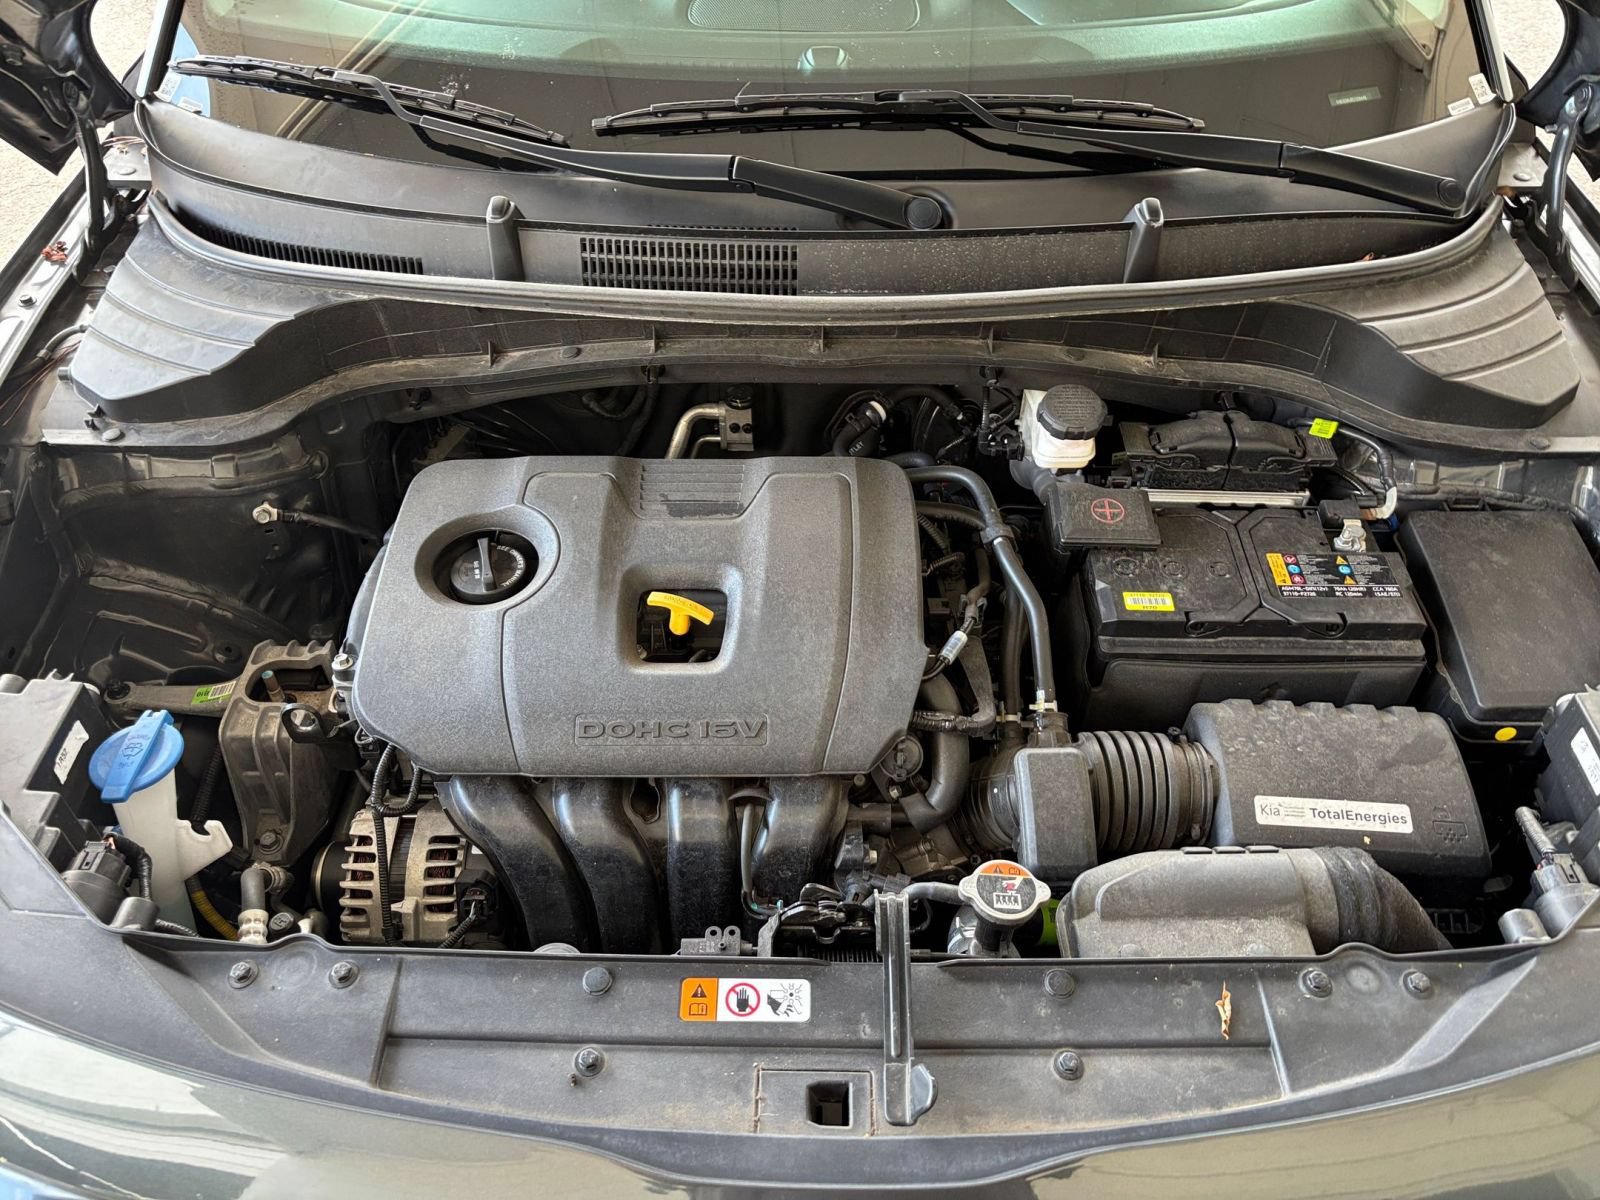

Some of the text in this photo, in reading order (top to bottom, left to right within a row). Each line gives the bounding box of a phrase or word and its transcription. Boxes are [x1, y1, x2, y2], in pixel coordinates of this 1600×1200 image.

[577, 720, 765, 739] DOHC 16V
[1259, 804, 1408, 825] Kia TotalEnergies
